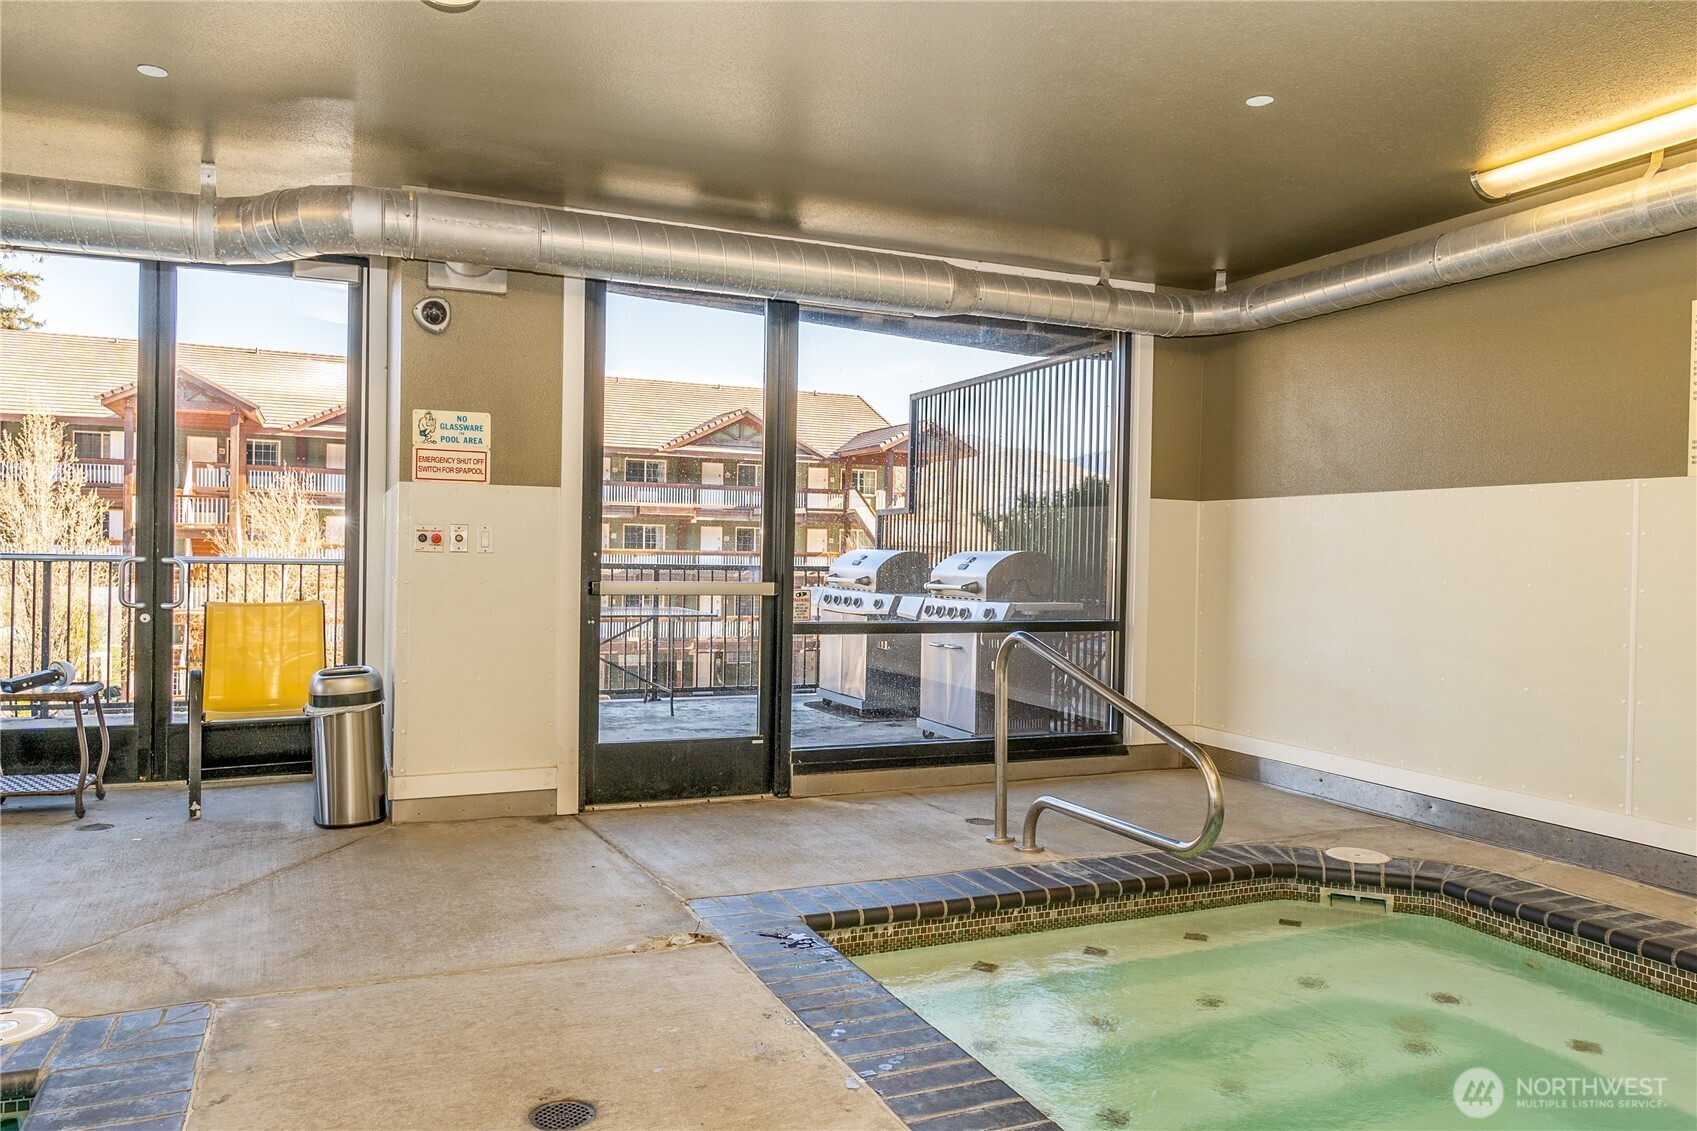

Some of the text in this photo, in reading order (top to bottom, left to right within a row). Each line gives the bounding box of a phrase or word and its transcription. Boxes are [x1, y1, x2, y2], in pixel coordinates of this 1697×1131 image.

[439, 422, 484, 432] GLASSWARE
[440, 435, 483, 445] POOL AREA
[418, 455, 484, 466] EMERGENCY SHUT OFF
[418, 465, 484, 475] SWITCH FOR SPA/POOL
